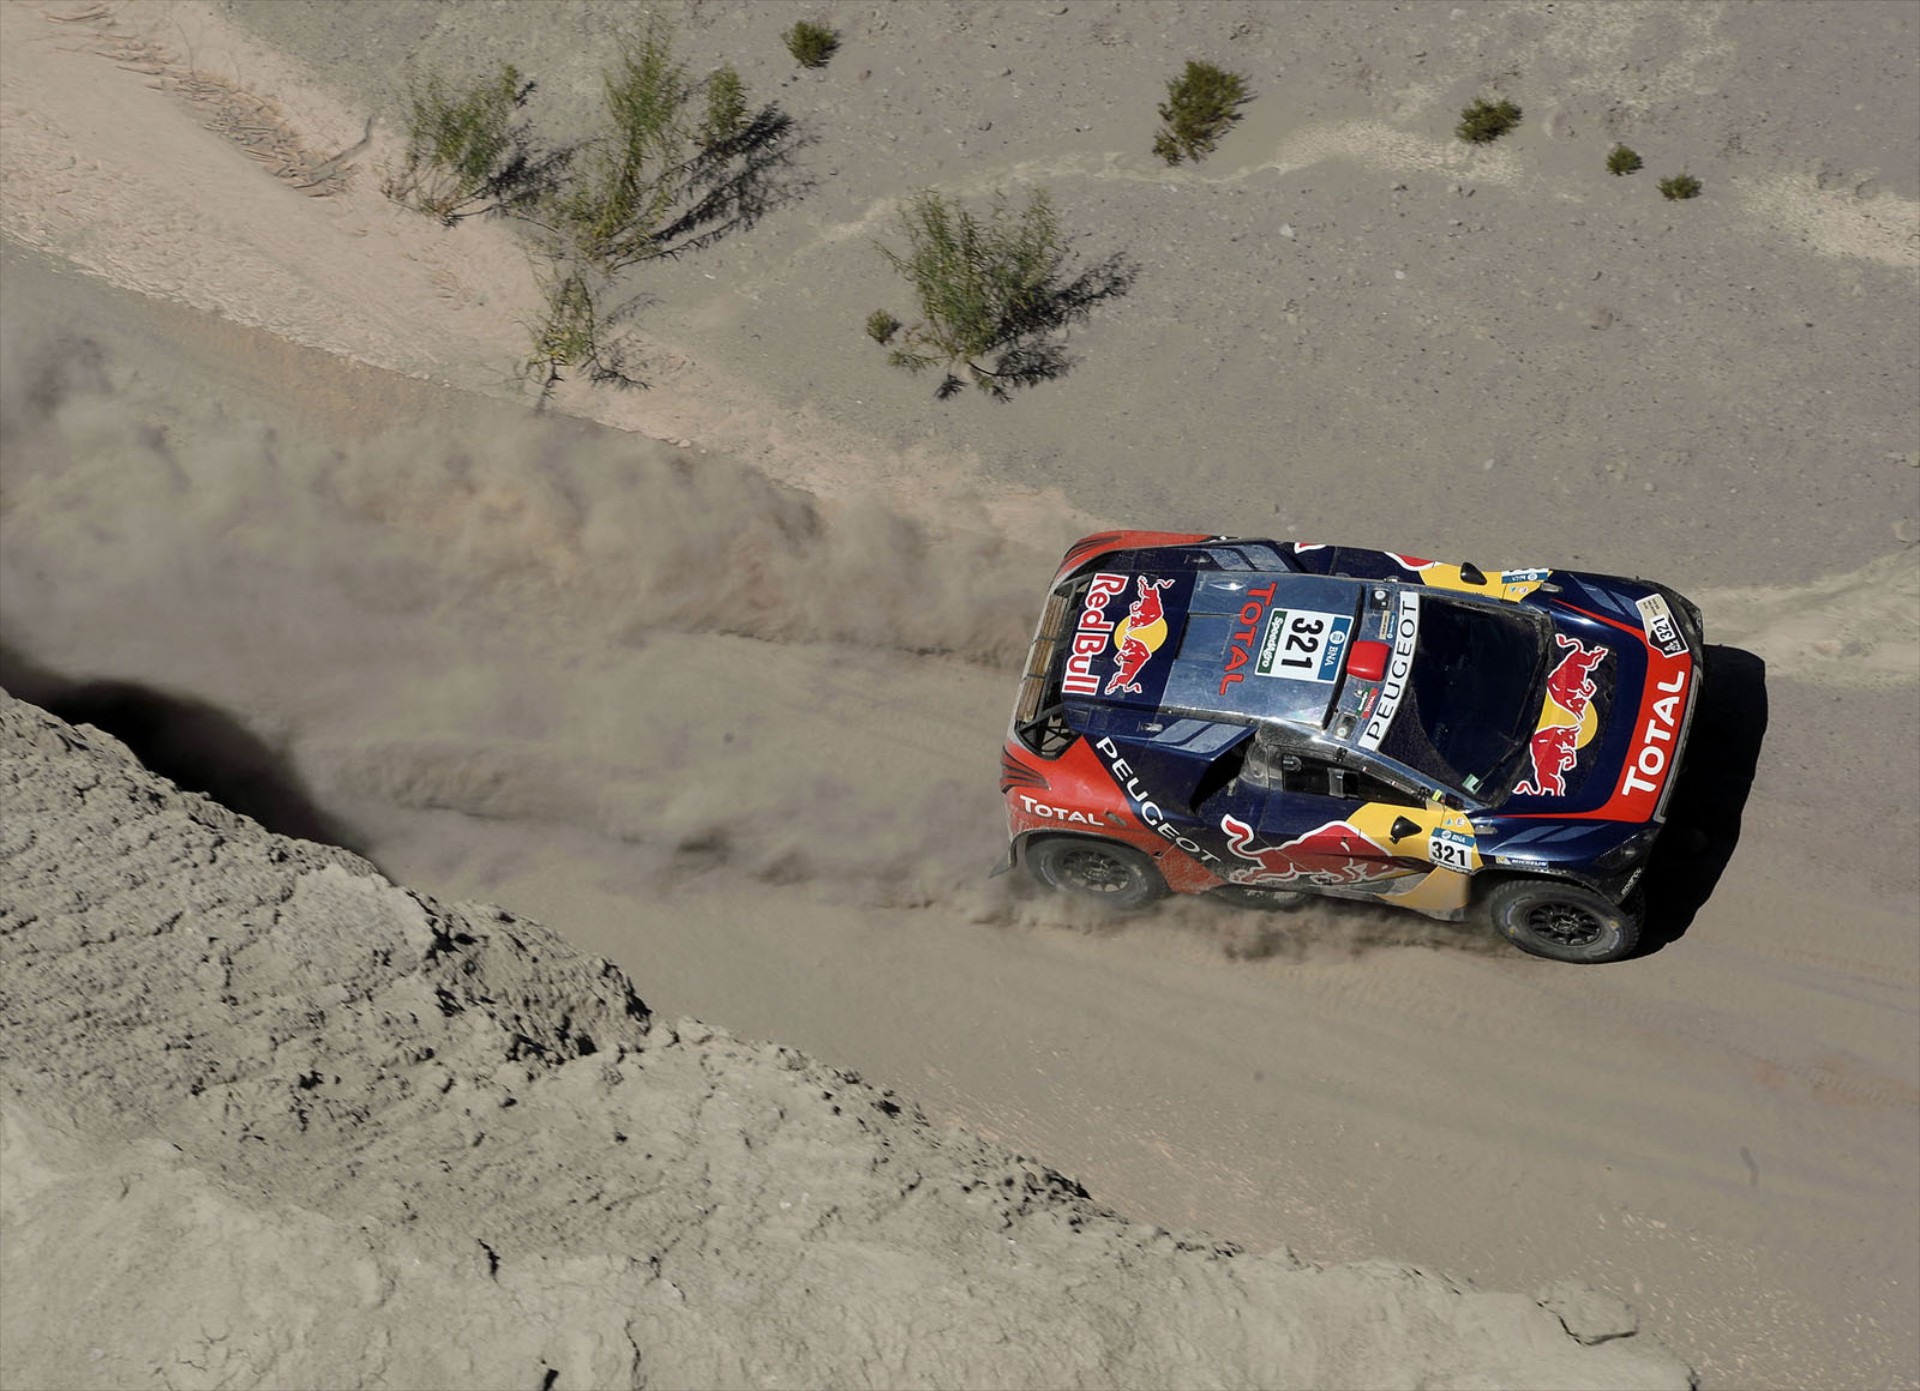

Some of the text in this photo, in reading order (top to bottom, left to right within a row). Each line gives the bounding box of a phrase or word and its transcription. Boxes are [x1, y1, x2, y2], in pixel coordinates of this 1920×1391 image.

[1062, 573, 1129, 696] Red Bull
[1219, 581, 1278, 696] TOTAL
[1281, 617, 1324, 669] 321
[1324, 645, 1339, 667] BNA
[1652, 617, 1673, 639] 321
[1366, 600, 1415, 740] PEUGEOT
[1622, 670, 1686, 796] TOTAL
[1020, 795, 1104, 827] TOTAL
[1096, 736, 1221, 863] PEUGEOT
[1432, 841, 1466, 867] 321
